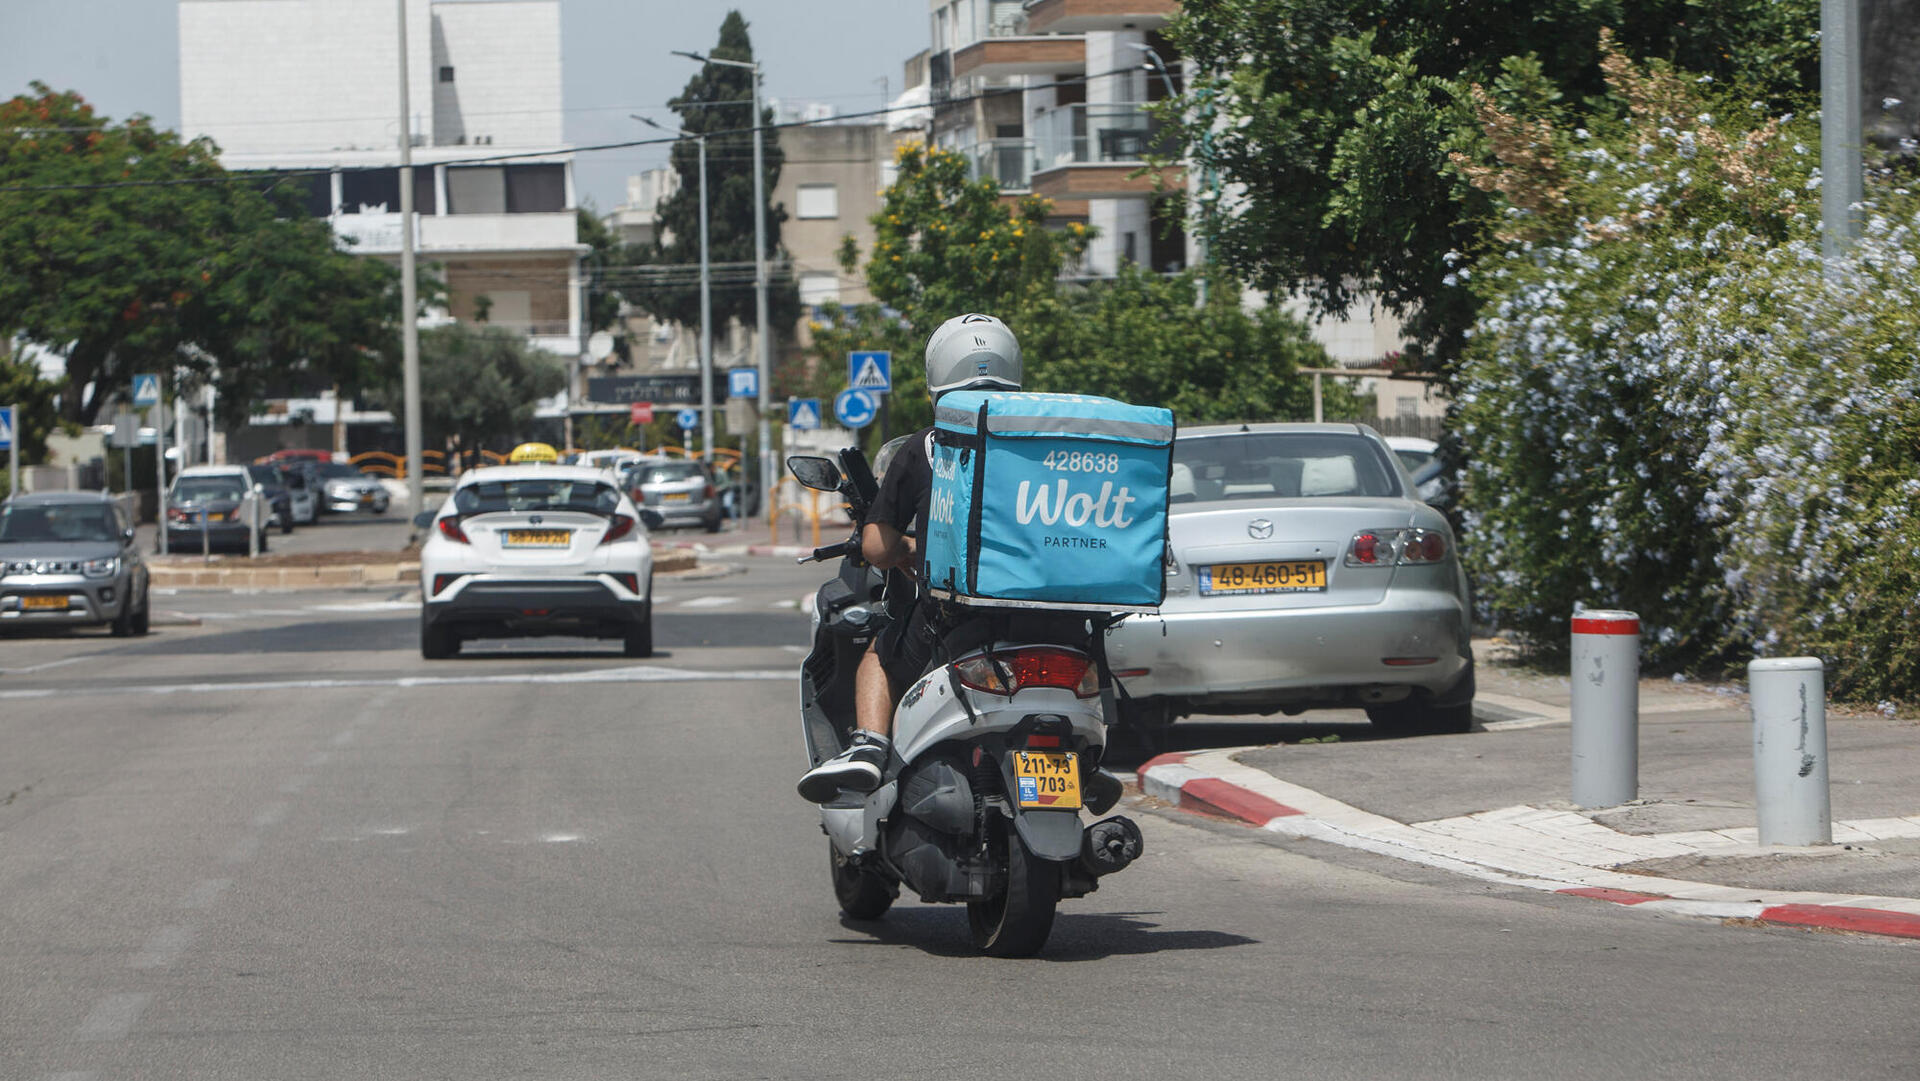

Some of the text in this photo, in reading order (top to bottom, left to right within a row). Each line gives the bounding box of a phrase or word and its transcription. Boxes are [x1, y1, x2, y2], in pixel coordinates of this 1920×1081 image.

[1043, 450, 1119, 474] 428638
[930, 487, 954, 525] Wolt
[1016, 478, 1136, 529] Wolt
[1044, 536, 1107, 549] PARTNER
[1022, 758, 1071, 774] 211-73
[1039, 776, 1066, 793] 703
